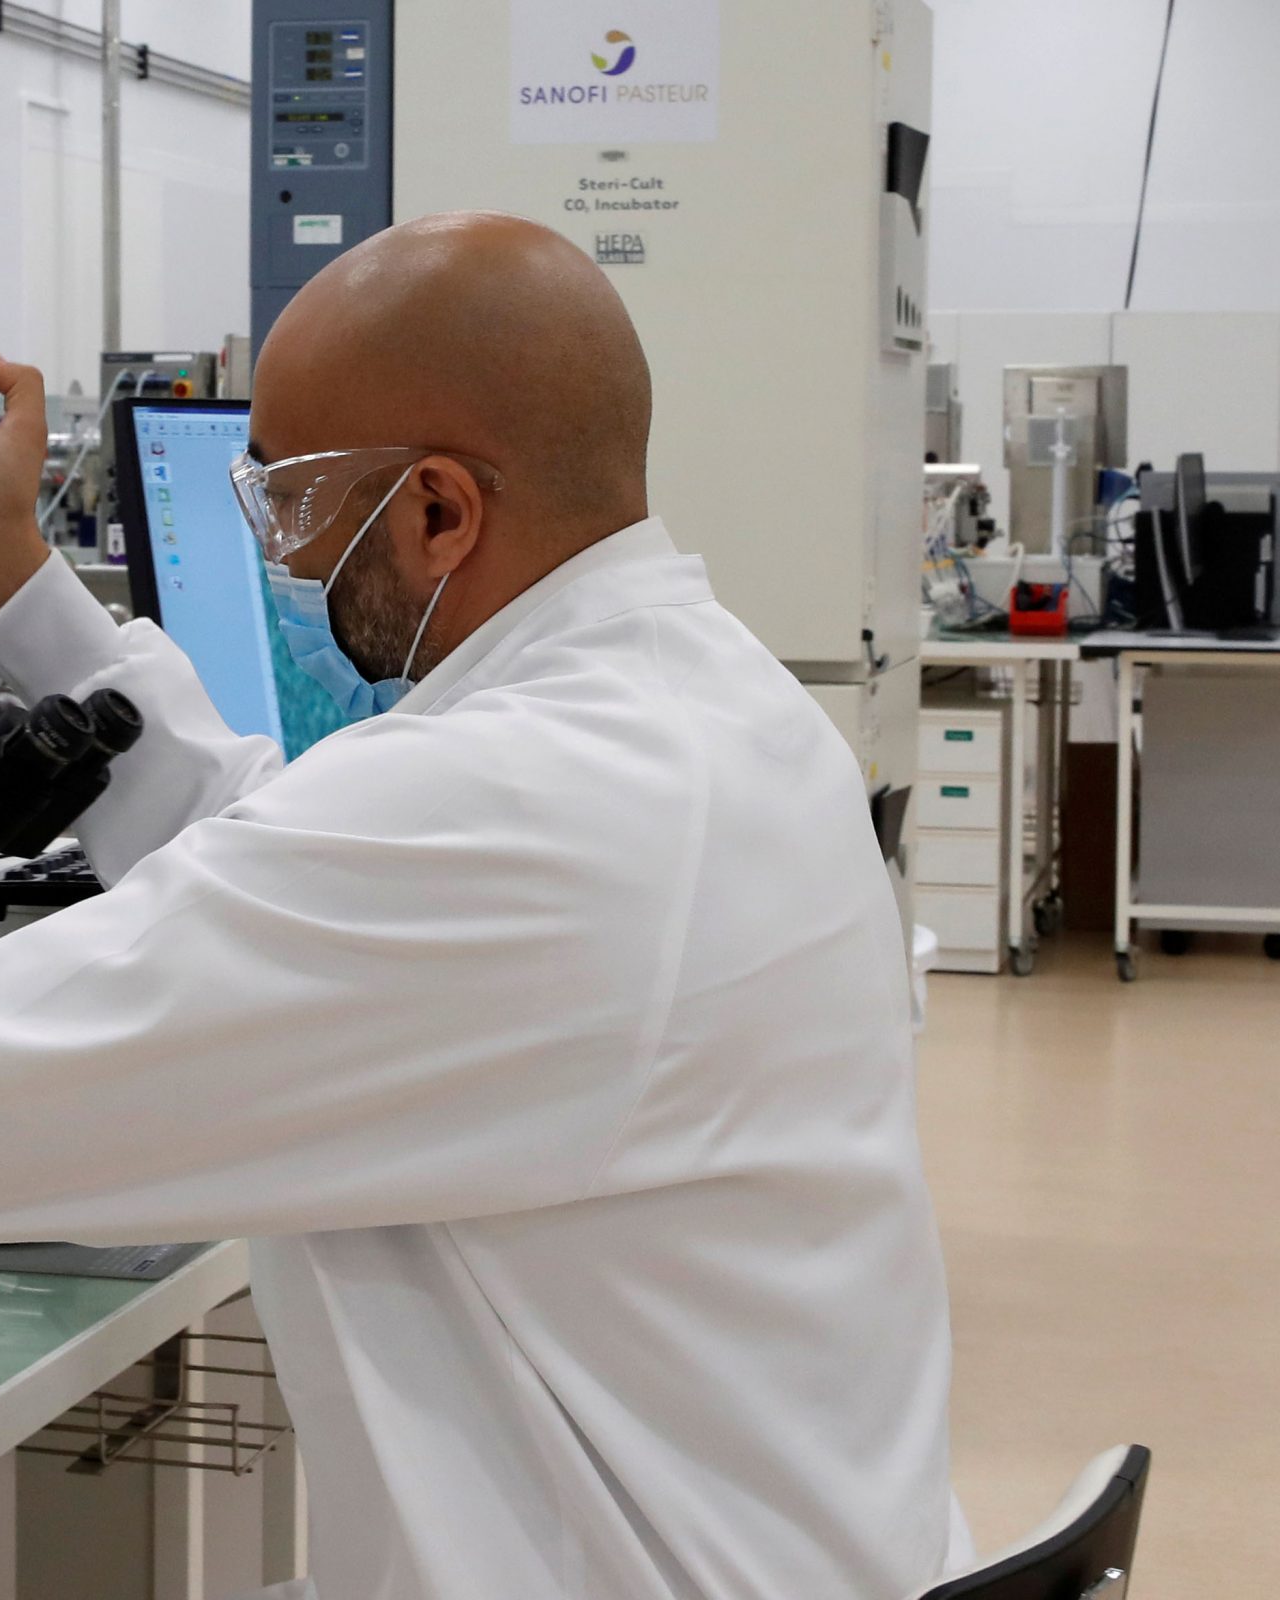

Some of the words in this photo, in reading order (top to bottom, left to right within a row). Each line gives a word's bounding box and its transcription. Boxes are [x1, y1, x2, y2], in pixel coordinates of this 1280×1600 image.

[520, 85, 607, 104] SANOFI
[616, 84, 709, 103] PASTEUR
[578, 177, 664, 190] Steri-Cult
[595, 198, 679, 211] Incubator
[595, 234, 644, 252] HEPA
